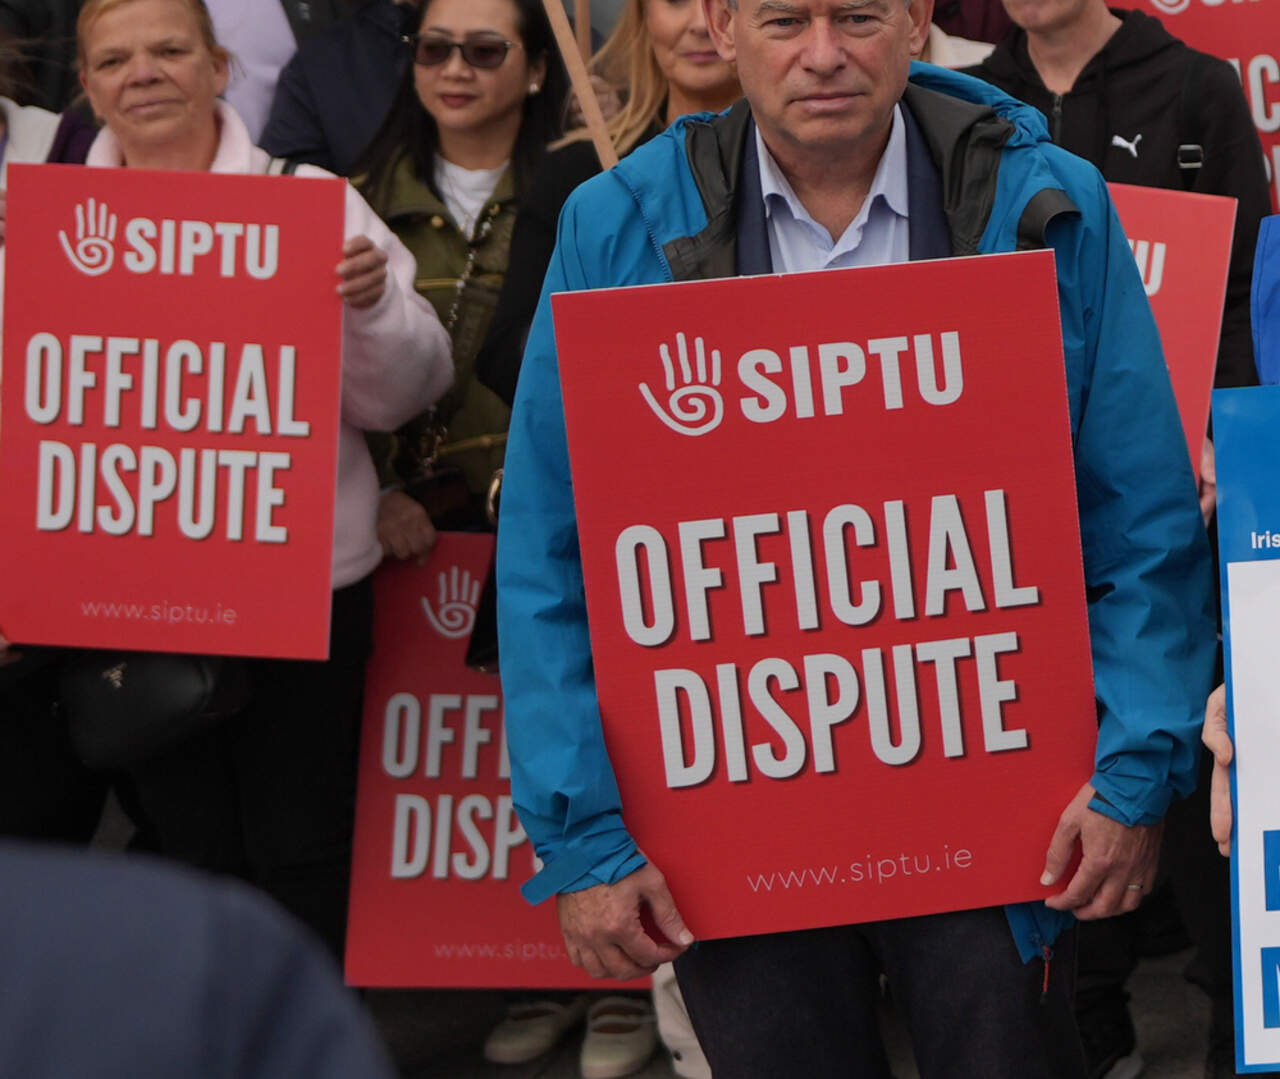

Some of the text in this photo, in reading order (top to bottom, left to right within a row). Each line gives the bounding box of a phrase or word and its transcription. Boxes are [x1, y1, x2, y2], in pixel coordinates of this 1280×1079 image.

[123, 217, 279, 279] SIPTU
[24, 333, 310, 437] OFFICIAL
[737, 331, 964, 423] SIPTU
[36, 440, 291, 544] DISPUTE
[81, 599, 238, 626] www.siptu.ie
[614, 488, 1040, 648] OFFICIAL
[654, 631, 1032, 790] DISPUTE
[391, 793, 540, 881] DISP
[747, 844, 974, 893] www.siptu.ie
[433, 936, 569, 962] www.siptu.
